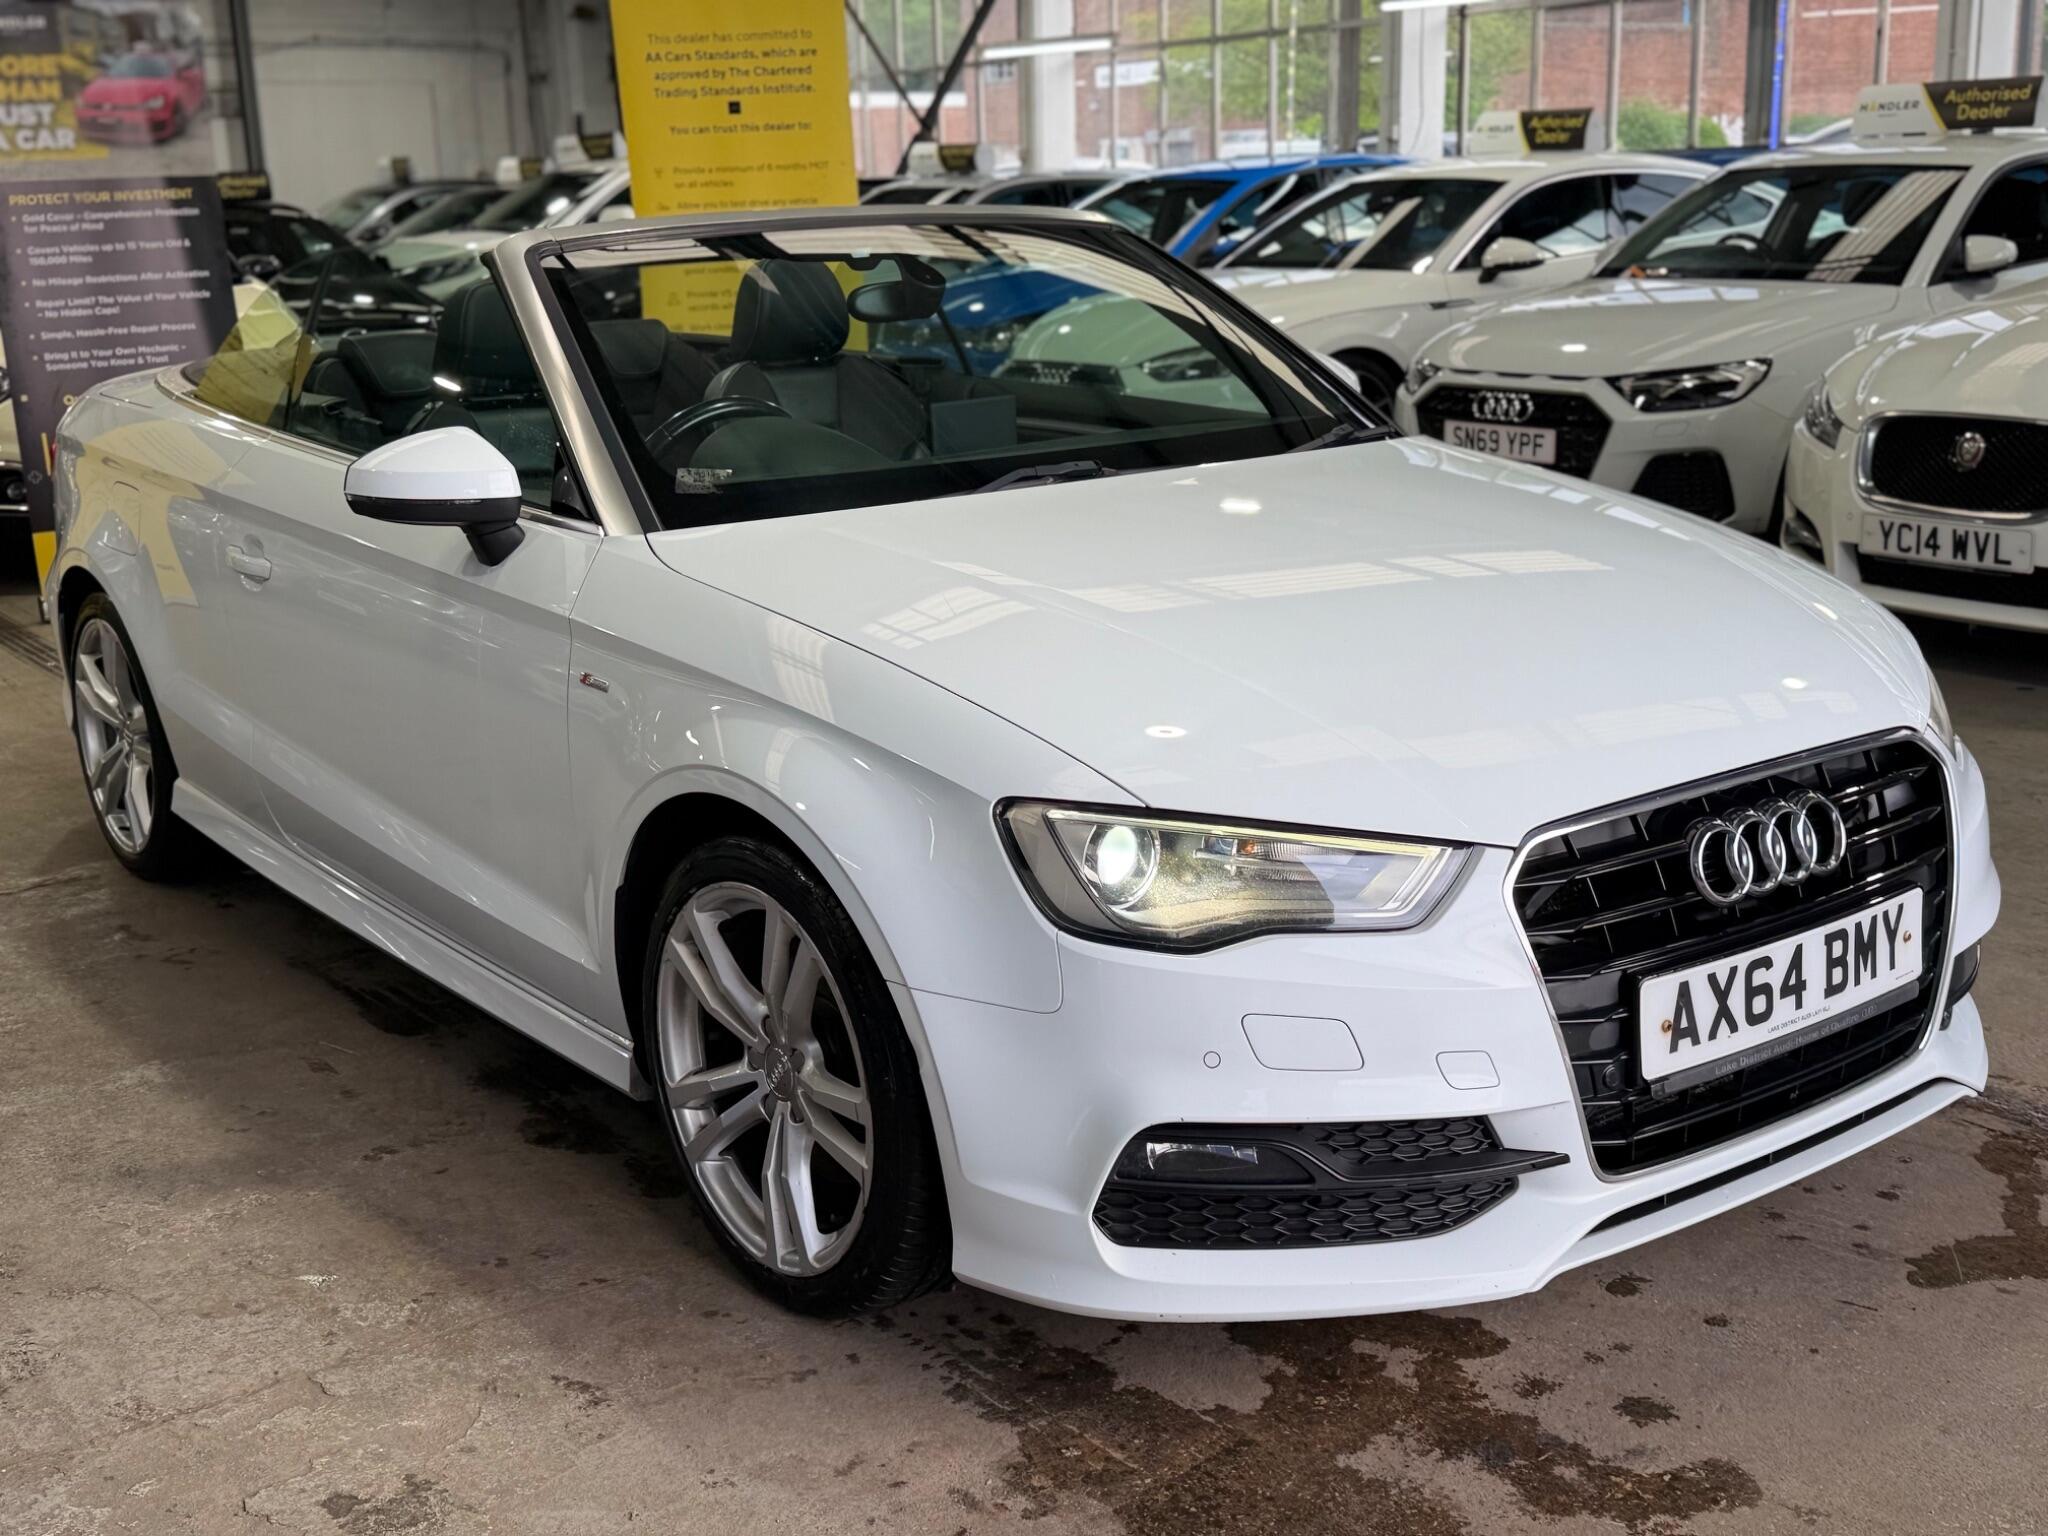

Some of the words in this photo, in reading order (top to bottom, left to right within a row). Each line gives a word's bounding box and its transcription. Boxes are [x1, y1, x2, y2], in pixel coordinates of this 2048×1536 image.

[648, 33, 672, 45] This
[674, 32, 709, 43] dealer
[713, 30, 732, 42] has
[736, 27, 798, 41] committed
[800, 27, 812, 39] to
[646, 51, 663, 62] AA
[665, 51, 692, 62] Cars
[695, 47, 759, 60] Standards,
[762, 47, 796, 58] which
[800, 47, 817, 57] are
[654, 69, 709, 81] approved
[712, 68, 725, 80] by
[729, 65, 750, 77] The
[753, 63, 812, 76] Chartered
[654, 86, 698, 99] Trading
[700, 83, 760, 96] Standards
[763, 82, 816, 95] Institute.
[1945, 84, 2033, 104] Authorised
[1956, 104, 2012, 121] Dealer
[669, 125, 689, 135] You
[692, 125, 711, 134] can
[713, 124, 738, 133] trust
[739, 122, 760, 132] this
[763, 120, 796, 132] dealer
[1530, 115, 1586, 129] Authorised
[16, 128, 76, 150] CAR
[1534, 131, 1571, 144] Dealer
[775, 162, 807, 171] months
[700, 180, 735, 188] vehicles
[9, 192, 69, 206] PROTECT
[73, 190, 110, 203] YOUR
[114, 186, 193, 201] INVESTMENT
[22, 214, 45, 223] Gold
[155, 206, 199, 216] Protection
[40, 223, 68, 232] Peace
[81, 222, 104, 231] Mind
[27, 246, 60, 255] Covers
[61, 244, 99, 253] Vehicles
[101, 244, 114, 252] up
[115, 242, 125, 250] to
[139, 240, 163, 249] Years
[165, 238, 182, 248] Old
[32, 279, 46, 287] No
[48, 278, 83, 287] Mileage
[85, 274, 138, 284] Restrictions
[140, 272, 162, 281] After
[165, 269, 210, 279] Activation
[35, 300, 65, 309] Repair
[97, 296, 115, 305] The
[116, 294, 141, 304] Value
[143, 293, 152, 301] of
[154, 293, 177, 301] Your
[179, 290, 211, 300] Vehicle
[44, 310, 58, 318] No
[60, 308, 93, 317] Hidden
[76, 326, 128, 338] Hassle-Free
[130, 324, 159, 334] Repair
[161, 323, 196, 332] Process
[43, 351, 69, 361] Bring
[91, 348, 113, 358] Your
[115, 347, 136, 356] Own
[138, 344, 179, 354] Mechanic
[46, 361, 88, 371] Someone
[90, 359, 109, 369] You
[110, 357, 135, 366] Know
[146, 354, 169, 363] Trust
[1453, 426, 1500, 453] SN69
[1506, 431, 1545, 457] YPF
[1879, 519, 1941, 557] YC14
[1952, 528, 2012, 566] WVL
[1669, 942, 1807, 1054] AX64
[1824, 902, 1904, 1000] BMY
[1715, 1062, 1738, 1076] Lake
[1740, 1049, 1772, 1067] District
